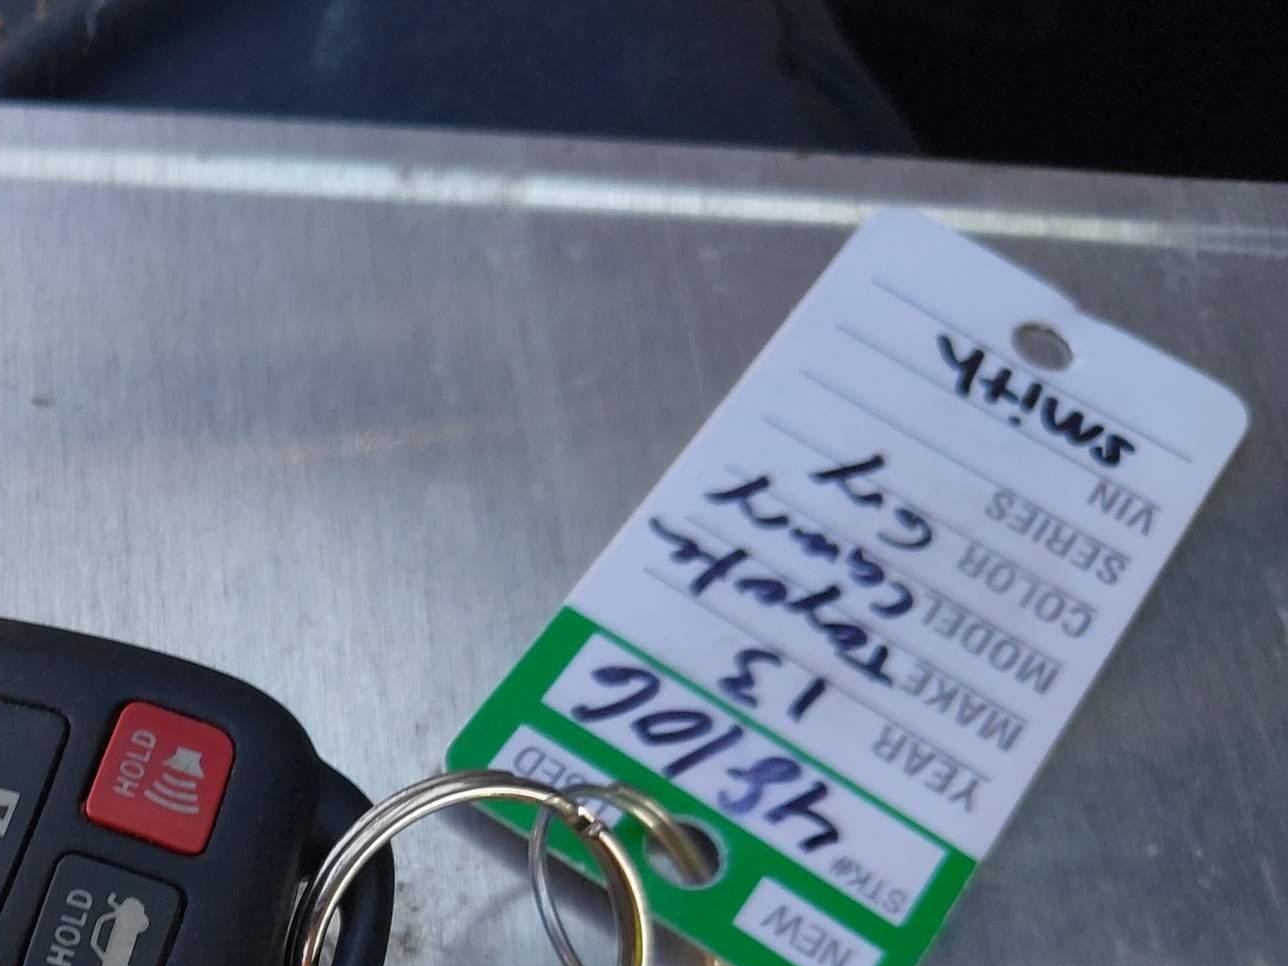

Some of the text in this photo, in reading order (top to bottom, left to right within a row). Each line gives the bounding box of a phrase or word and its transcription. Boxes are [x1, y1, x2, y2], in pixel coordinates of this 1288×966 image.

[984, 488, 1129, 586] SERIES
[1087, 481, 1159, 537] VIN
[956, 544, 1094, 639] COLOR
[718, 648, 826, 722] 13
[921, 592, 1060, 695] MODEL
[898, 669, 1027, 752] MAKE
[112, 729, 157, 799] HOLD
[570, 665, 845, 855] 48106
[871, 723, 984, 813] YEAR
[828, 856, 910, 915] STK#
